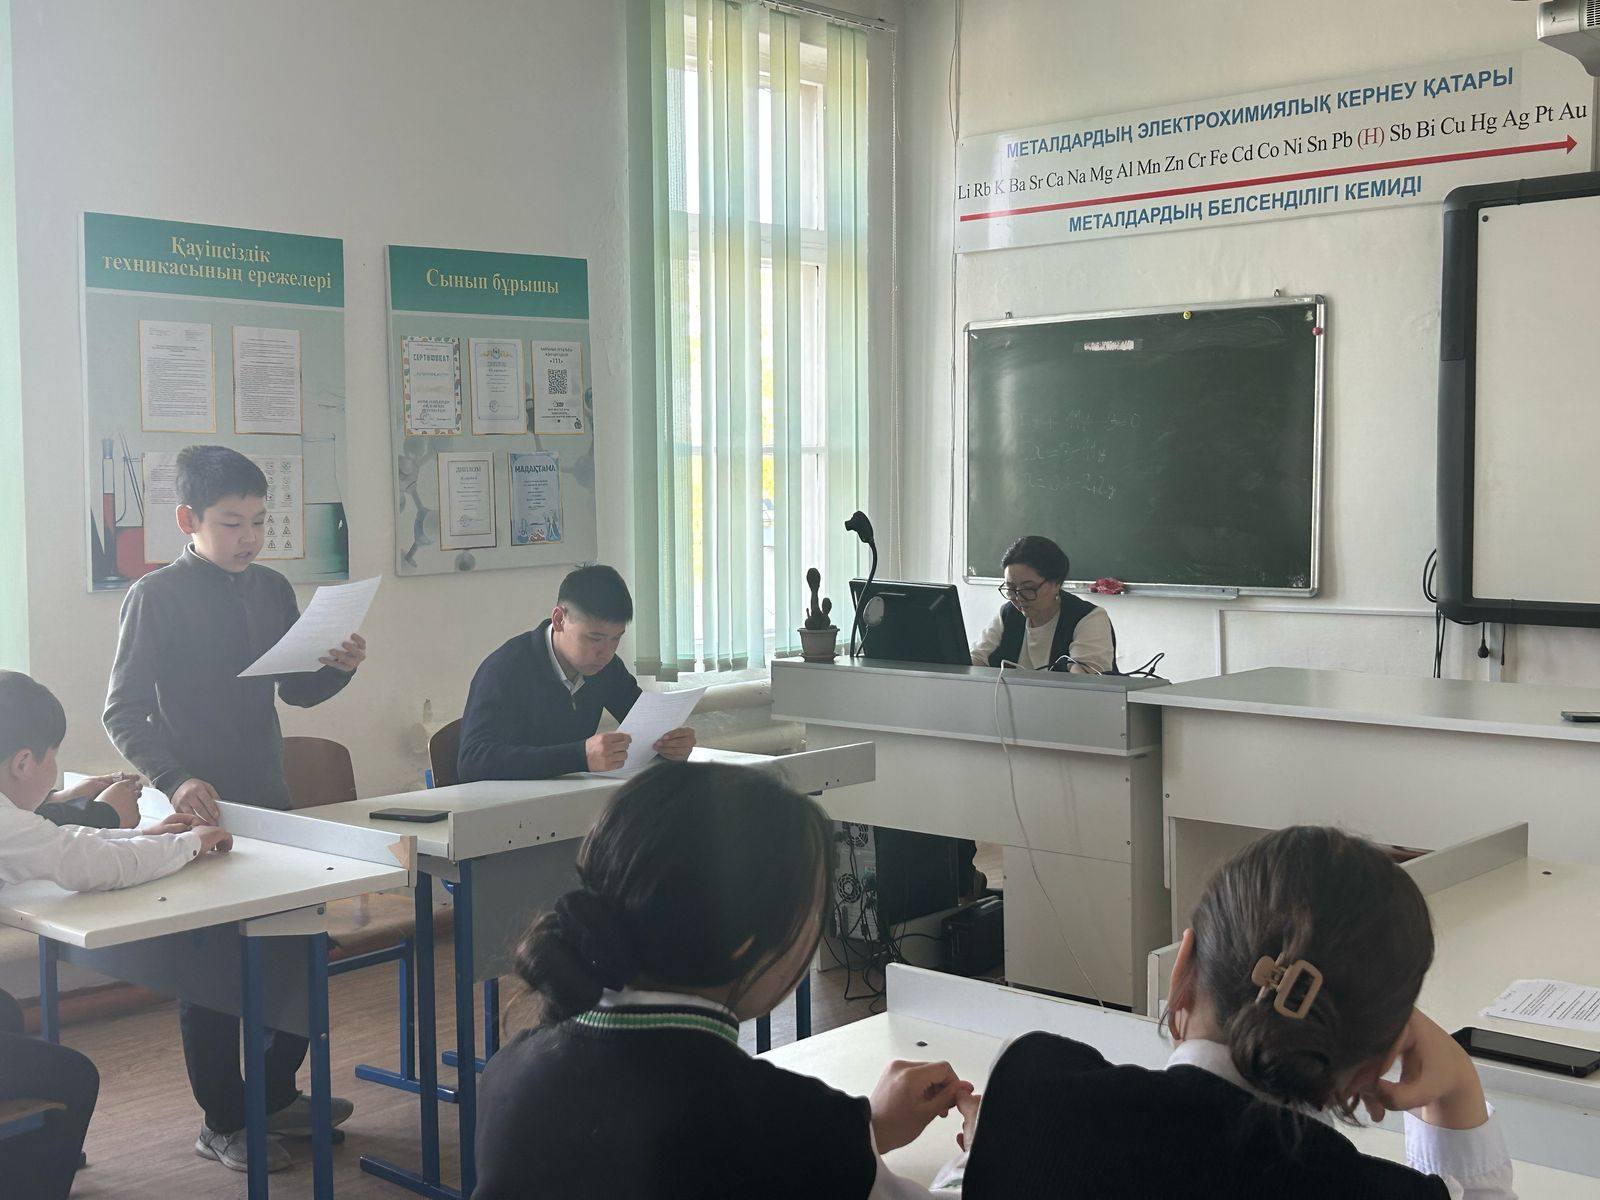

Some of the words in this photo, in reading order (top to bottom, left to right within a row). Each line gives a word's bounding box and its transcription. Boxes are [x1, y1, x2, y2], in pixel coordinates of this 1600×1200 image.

[1007, 126, 1133, 158] МЕТАЛДАРДЫҢ
[1138, 94, 1331, 138] ЭЛЕКТРОХИМИЯЛЫҚ
[1337, 81, 1417, 109] КЕРНЕУ
[1423, 67, 1513, 98] ҚАТАРЫ
[958, 185, 970, 199] Li
[974, 182, 991, 198] Rb
[995, 179, 1005, 194] K
[1009, 178, 1026, 193] Ba
[1029, 175, 1043, 190] Sr
[1046, 172, 1064, 188] Ca
[1067, 169, 1086, 185] Na
[1090, 165, 1113, 184] Mg
[1116, 161, 1133, 178] Al
[1137, 158, 1161, 175] Mn
[1165, 155, 1184, 172] Zn
[1188, 152, 1206, 169] Cr
[1210, 149, 1228, 166] Fe
[1232, 144, 1253, 163] Cd
[1257, 142, 1280, 159] Co
[1283, 138, 1302, 156] Ni
[1307, 136, 1327, 153] Sn
[1332, 131, 1352, 149] Pb
[1357, 126, 1385, 150] (H)
[1390, 123, 1411, 142] Sb
[1416, 118, 1435, 138] Bi
[1440, 116, 1466, 135] Cu
[1470, 112, 1497, 134] Hg
[1502, 110, 1530, 130] Ag
[1535, 105, 1554, 123] Pt
[1558, 102, 1587, 121] Au
[1069, 201, 1203, 232] МЕТАЛДАРДЫҢ
[1208, 185, 1338, 216] БЕЛСЕНДІЛІГІ
[1345, 176, 1422, 200] КЕМИДІ
[171, 236, 271, 263] Қауіпсіздік
[102, 255, 243, 283] техникасының
[248, 267, 332, 292] ережелері
[426, 268, 488, 290] Сынып
[493, 273, 559, 296] бұрышы
